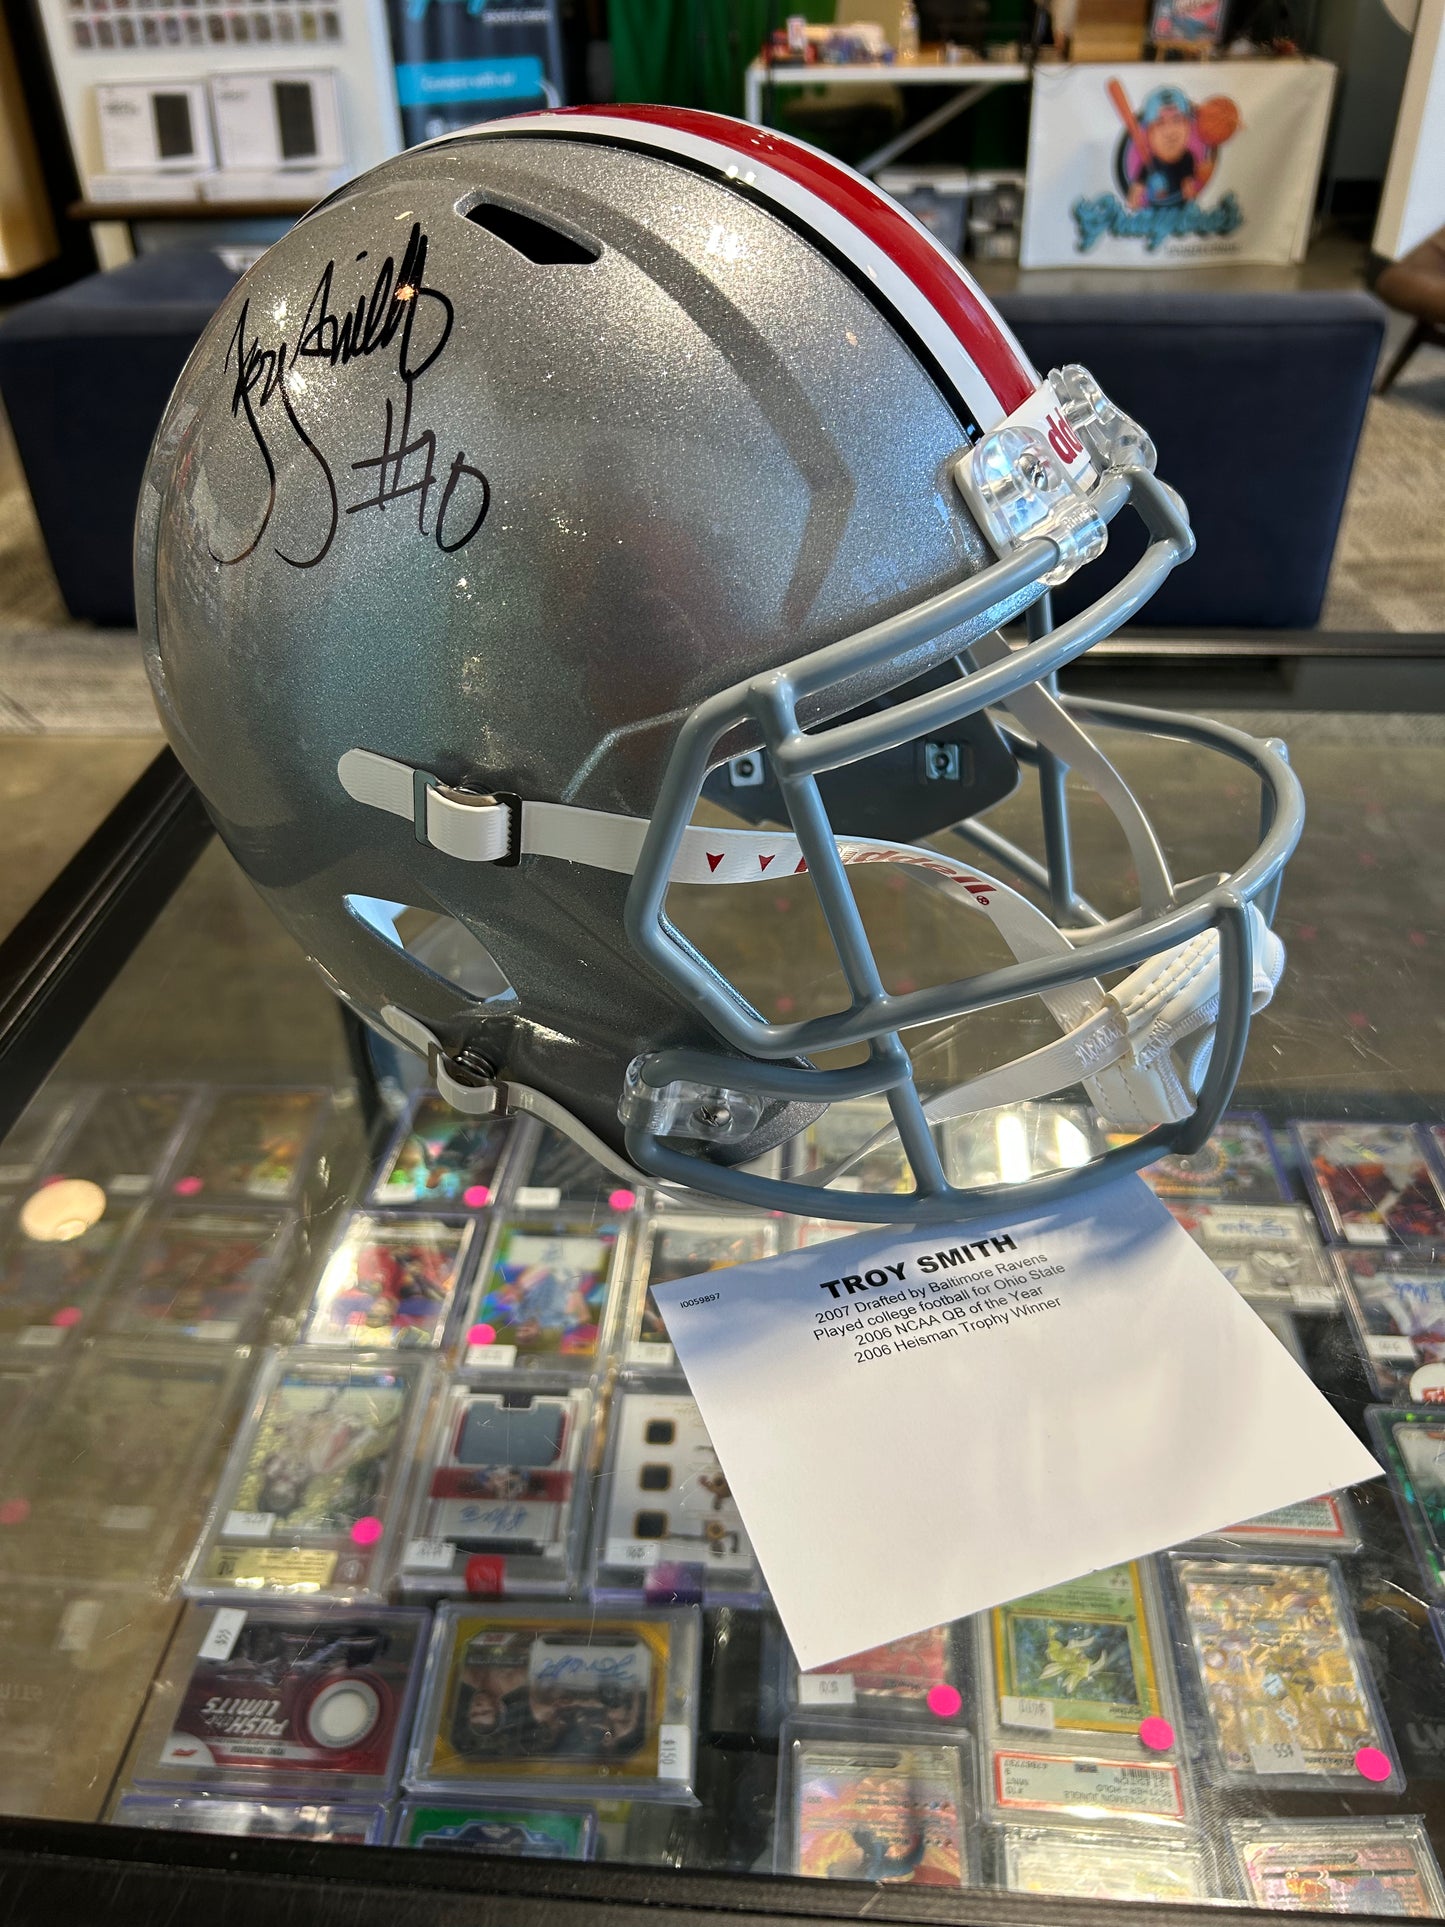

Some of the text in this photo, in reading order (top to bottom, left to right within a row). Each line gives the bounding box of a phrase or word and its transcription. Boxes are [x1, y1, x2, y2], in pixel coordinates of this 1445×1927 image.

[815, 1253, 1048, 1324] 2007 Drafted by Baltimore Ravens
[820, 1234, 1018, 1299] TROY SMITH
[813, 1263, 1066, 1342] Played college football for Ohio State
[854, 1297, 1062, 1364] 2006 Heisman Trophy Winner
[855, 1285, 1044, 1347] 2006 NCAA QB of the Year
[201, 1696, 281, 1714] LIMITS
[228, 1715, 289, 1736] PUSH
